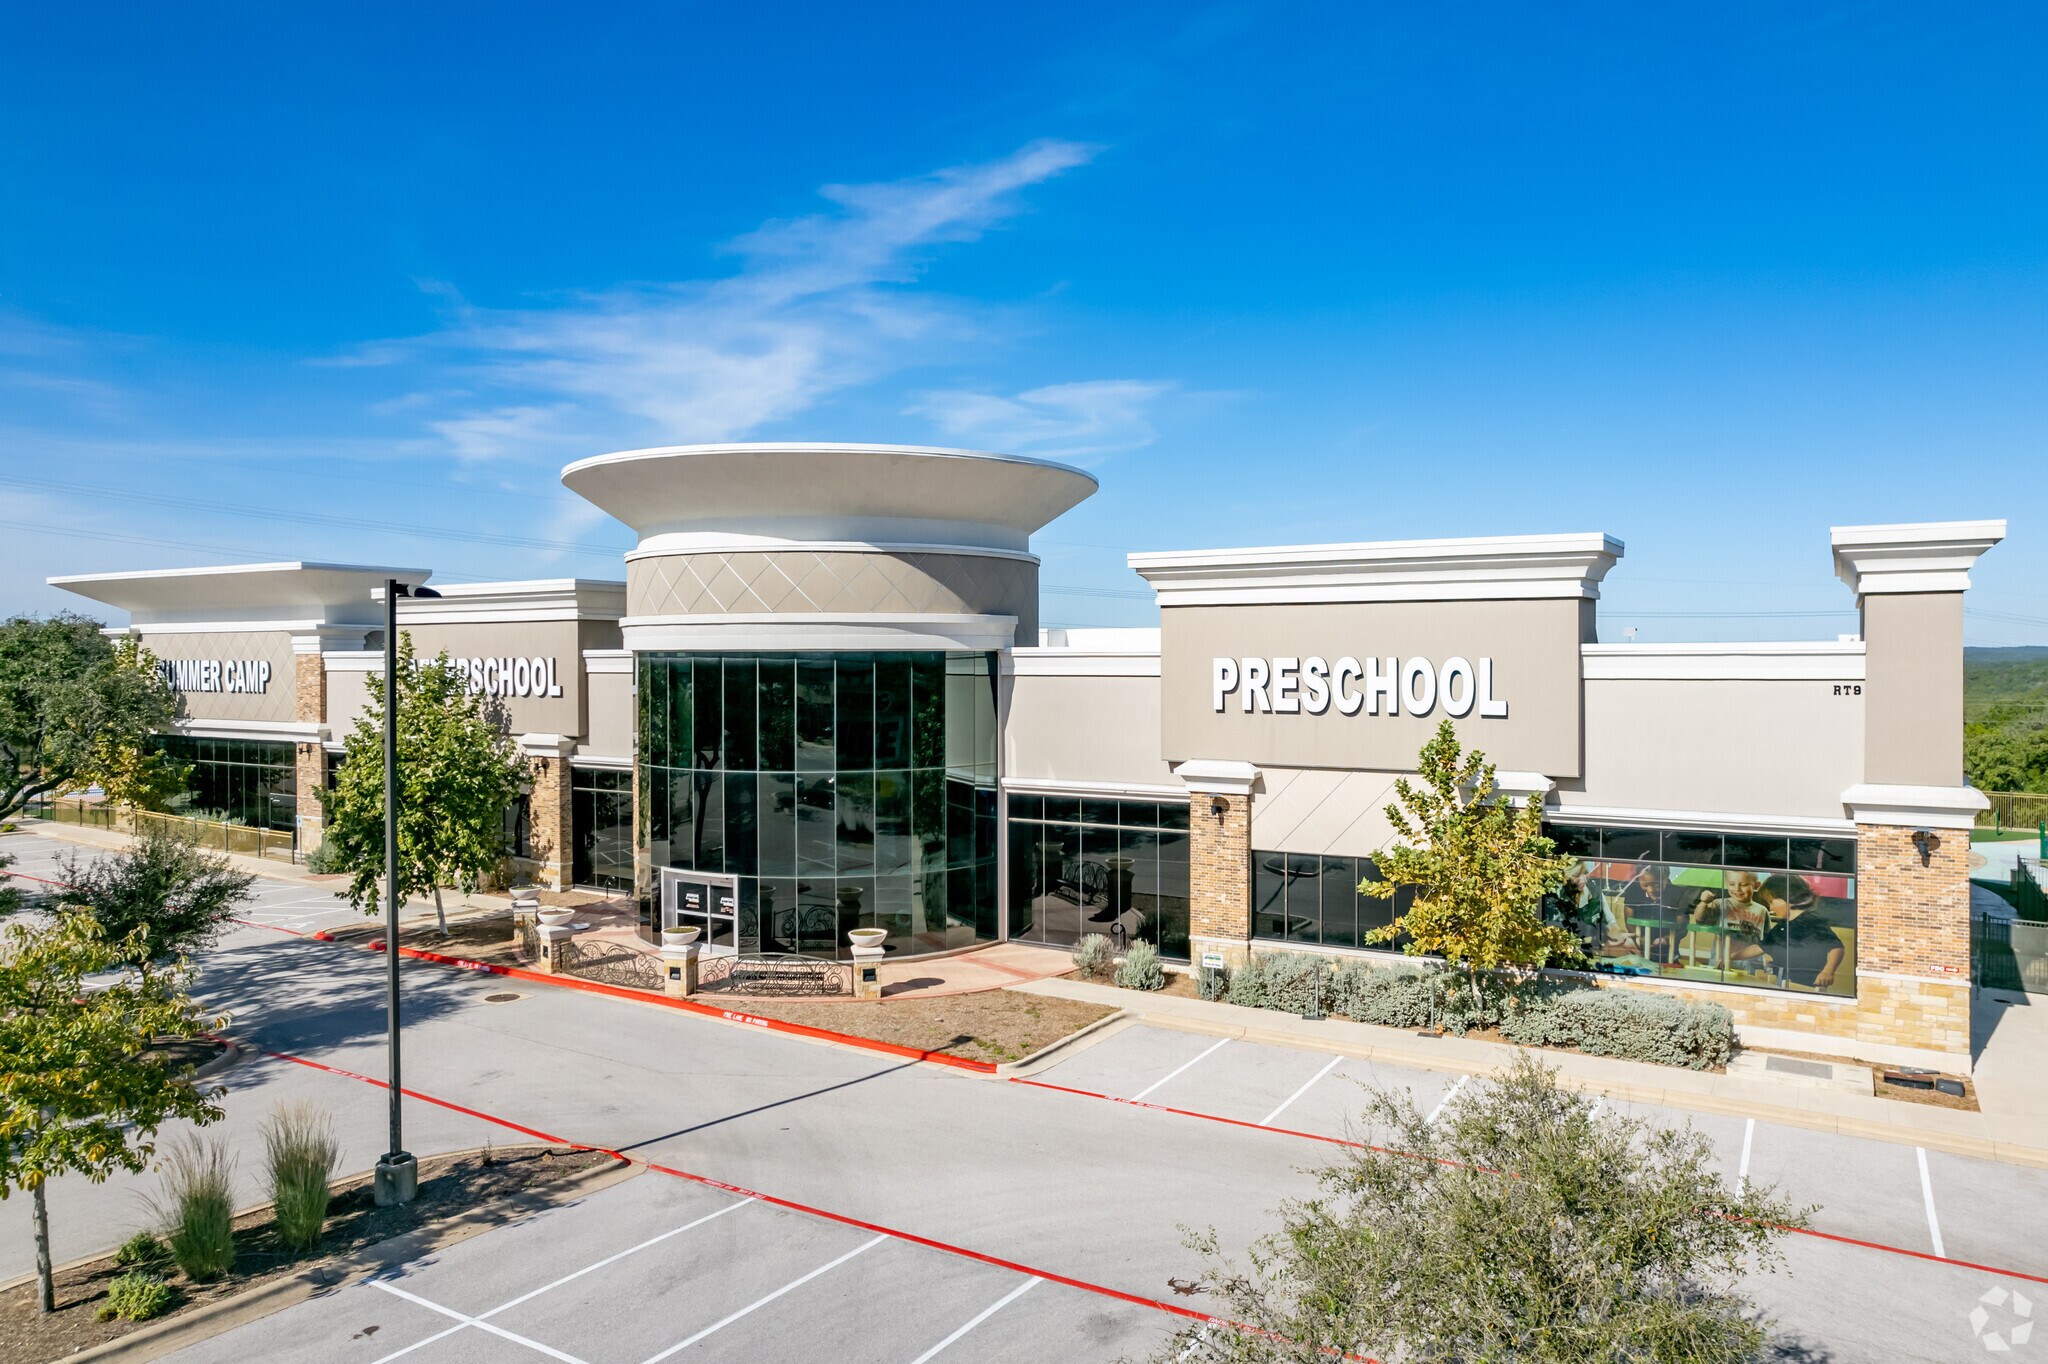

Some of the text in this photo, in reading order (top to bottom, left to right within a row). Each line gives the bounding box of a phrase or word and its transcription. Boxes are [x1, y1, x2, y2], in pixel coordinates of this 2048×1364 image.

[225, 659, 271, 694] CAMP
[1212, 656, 1508, 718] PRESCHOOL
[1833, 685, 1862, 696] RT9
